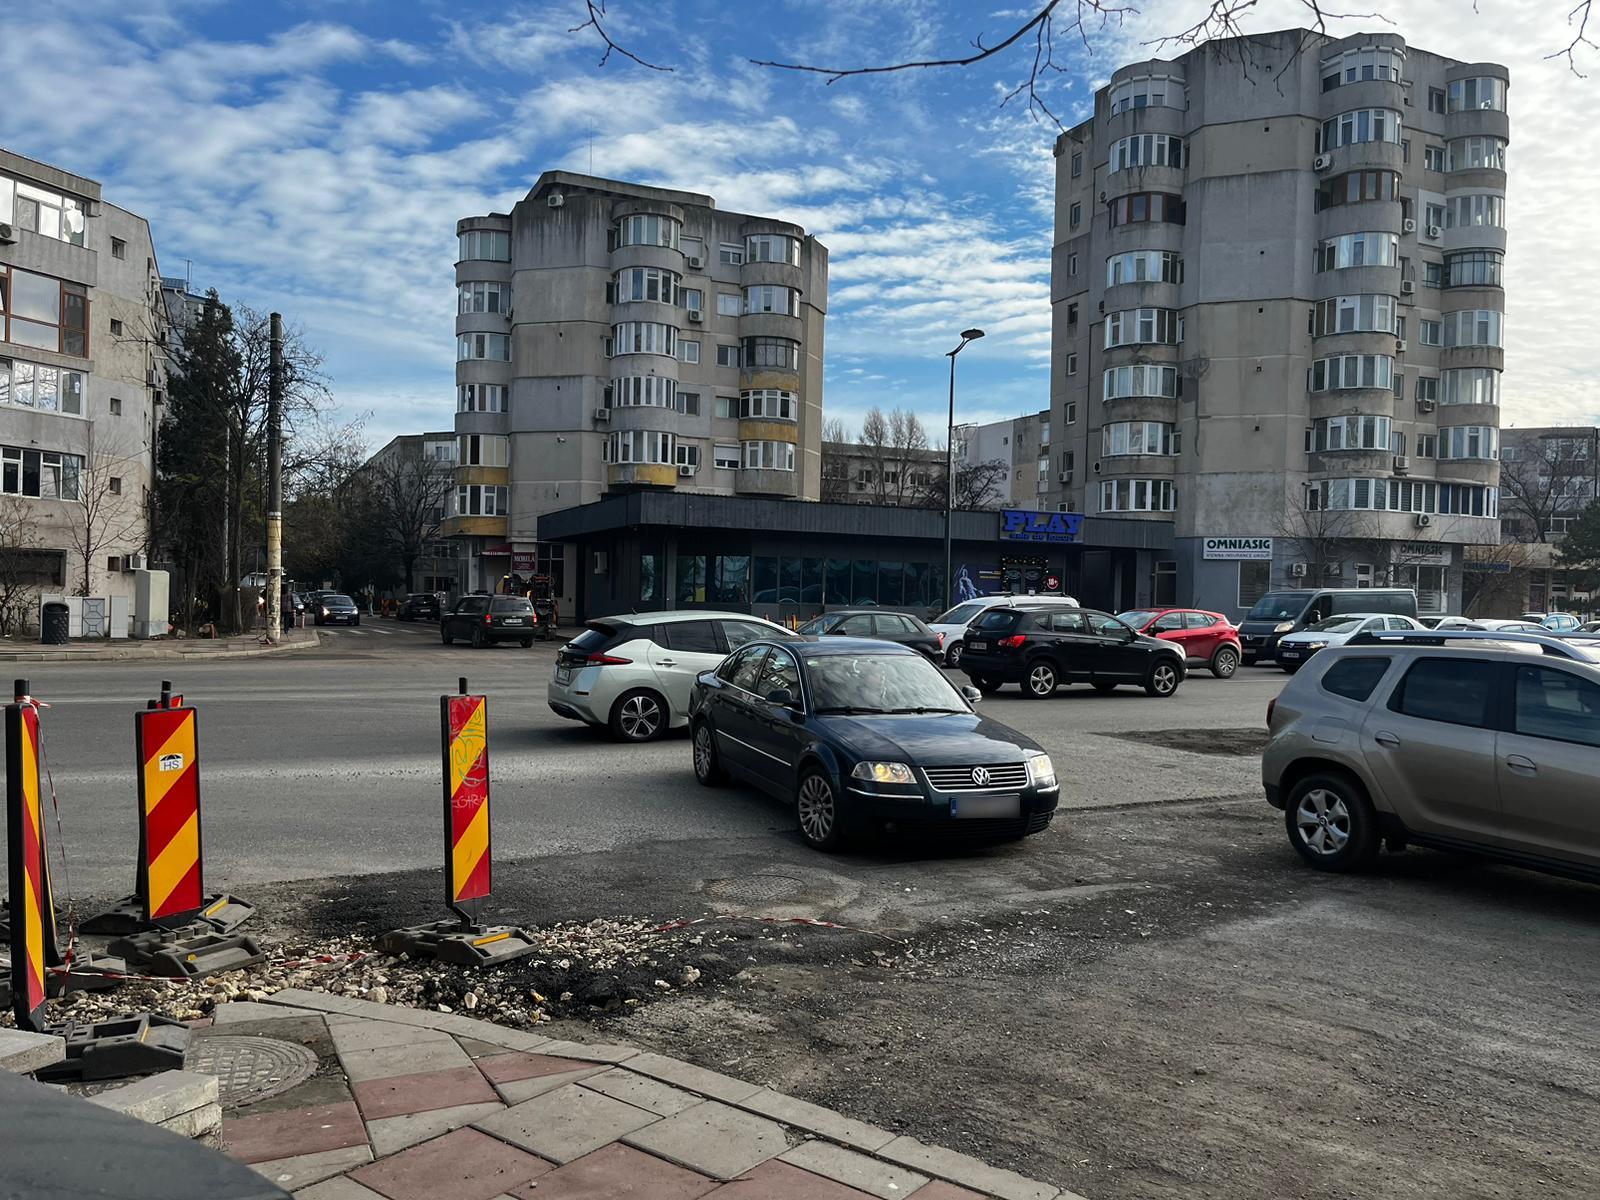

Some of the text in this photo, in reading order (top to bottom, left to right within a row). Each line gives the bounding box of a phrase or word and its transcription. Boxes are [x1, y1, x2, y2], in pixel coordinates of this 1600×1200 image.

[1003, 511, 1083, 535] PLAY
[1206, 539, 1271, 549] OMNIASIG
[163, 760, 179, 770] HS
